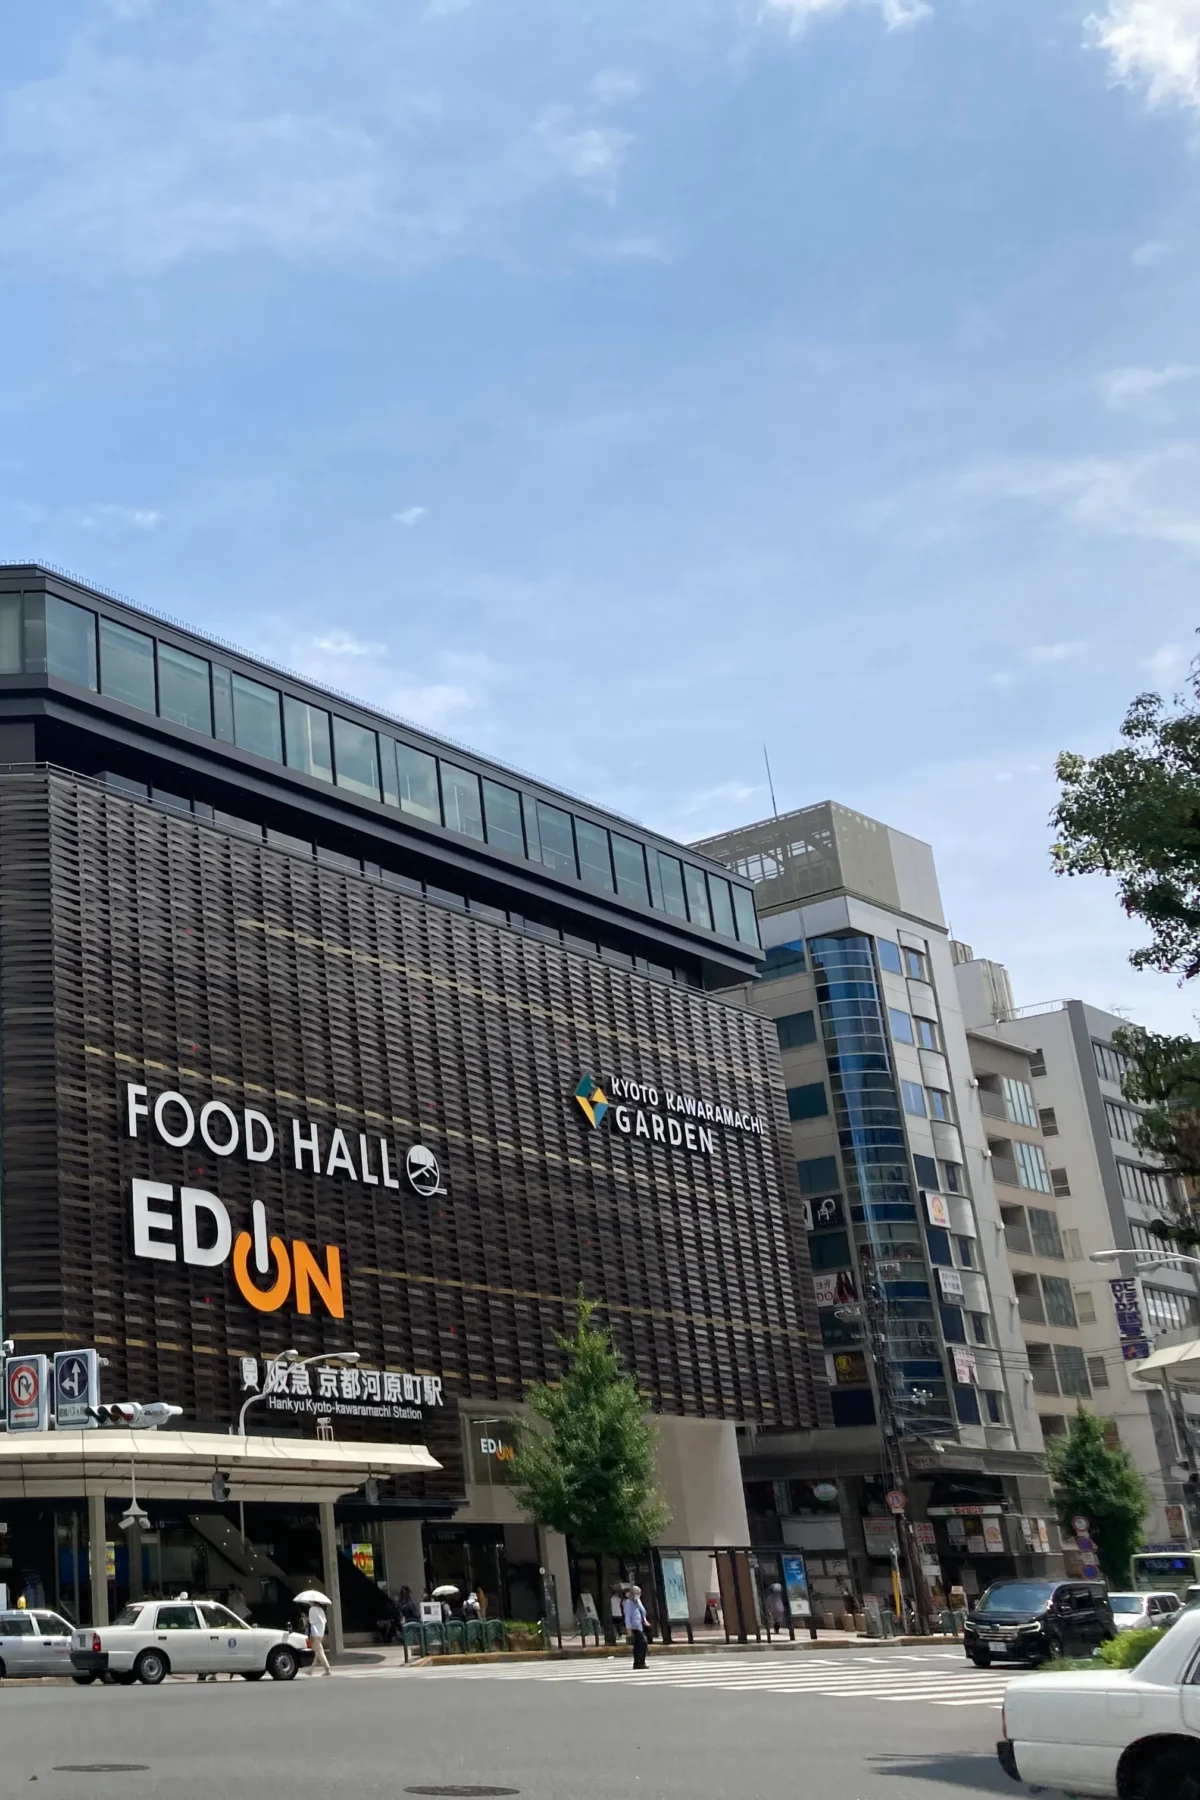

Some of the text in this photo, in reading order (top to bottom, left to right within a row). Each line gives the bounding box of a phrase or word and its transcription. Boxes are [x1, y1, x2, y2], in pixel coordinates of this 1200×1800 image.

[611, 1077, 765, 1135] KYOTO KAWARAMACHI
[615, 1105, 714, 1155] GARDEN
[127, 1083, 400, 1189] FOOD HALL
[131, 1177, 345, 1319] EDION
[265, 1360, 444, 1407] 阪急 京都河原町駅
[269, 1396, 423, 1420] Hankyu Kyoto-kawaramachi Station
[480, 1438, 514, 1461] EDION
